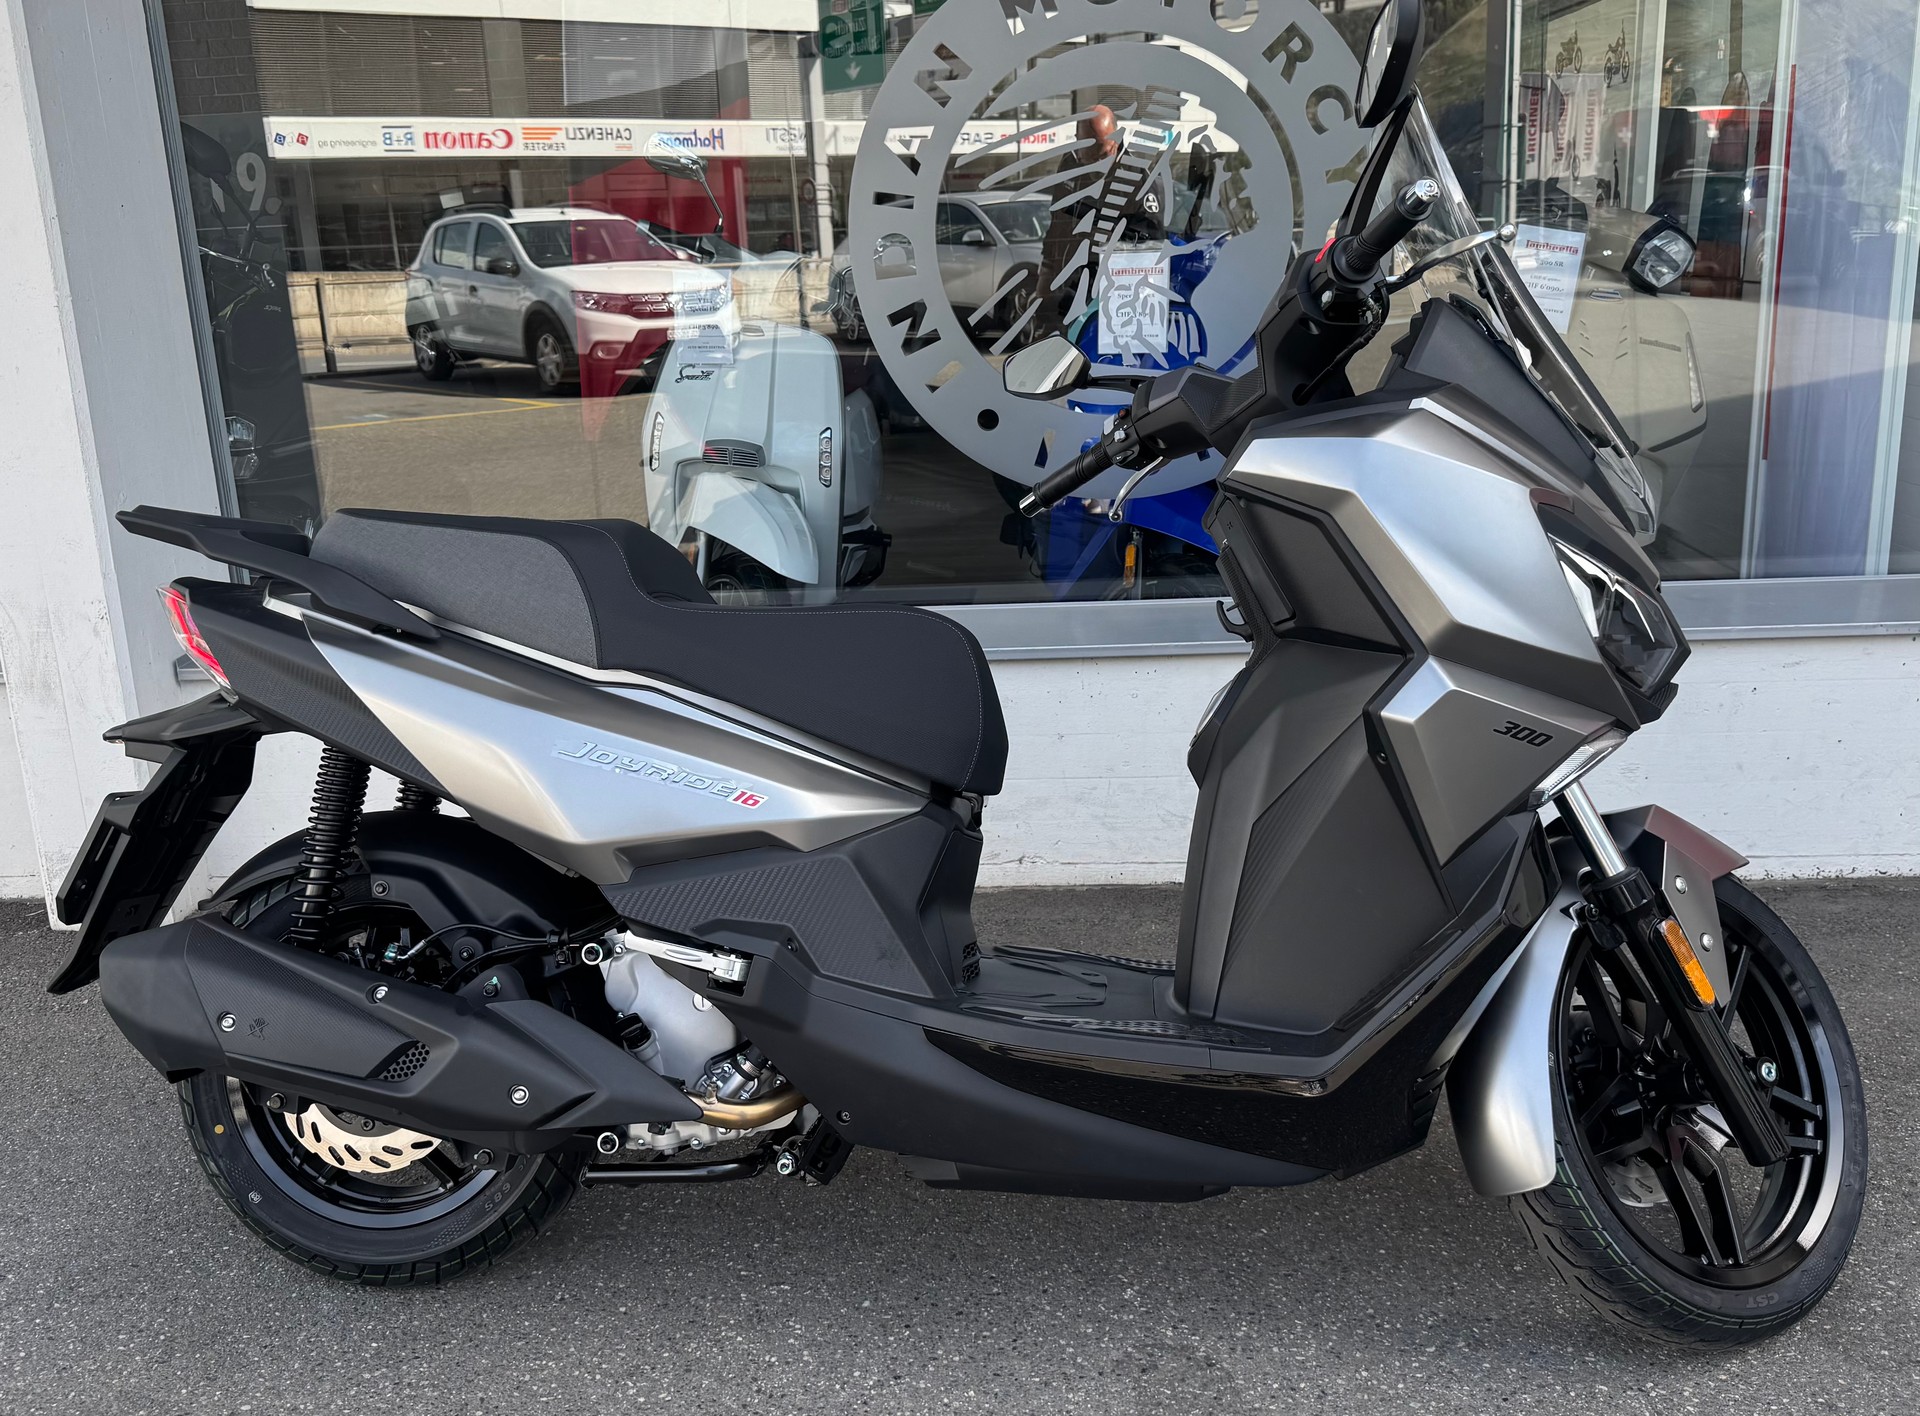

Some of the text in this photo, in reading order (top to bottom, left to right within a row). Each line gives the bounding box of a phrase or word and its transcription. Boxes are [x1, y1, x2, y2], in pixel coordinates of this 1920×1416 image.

[1527, 88, 1540, 153] RICHNER
[1493, 720, 1554, 748] 300
[557, 740, 738, 797] JOYRIDE
[1745, 1291, 1780, 1309] CST
